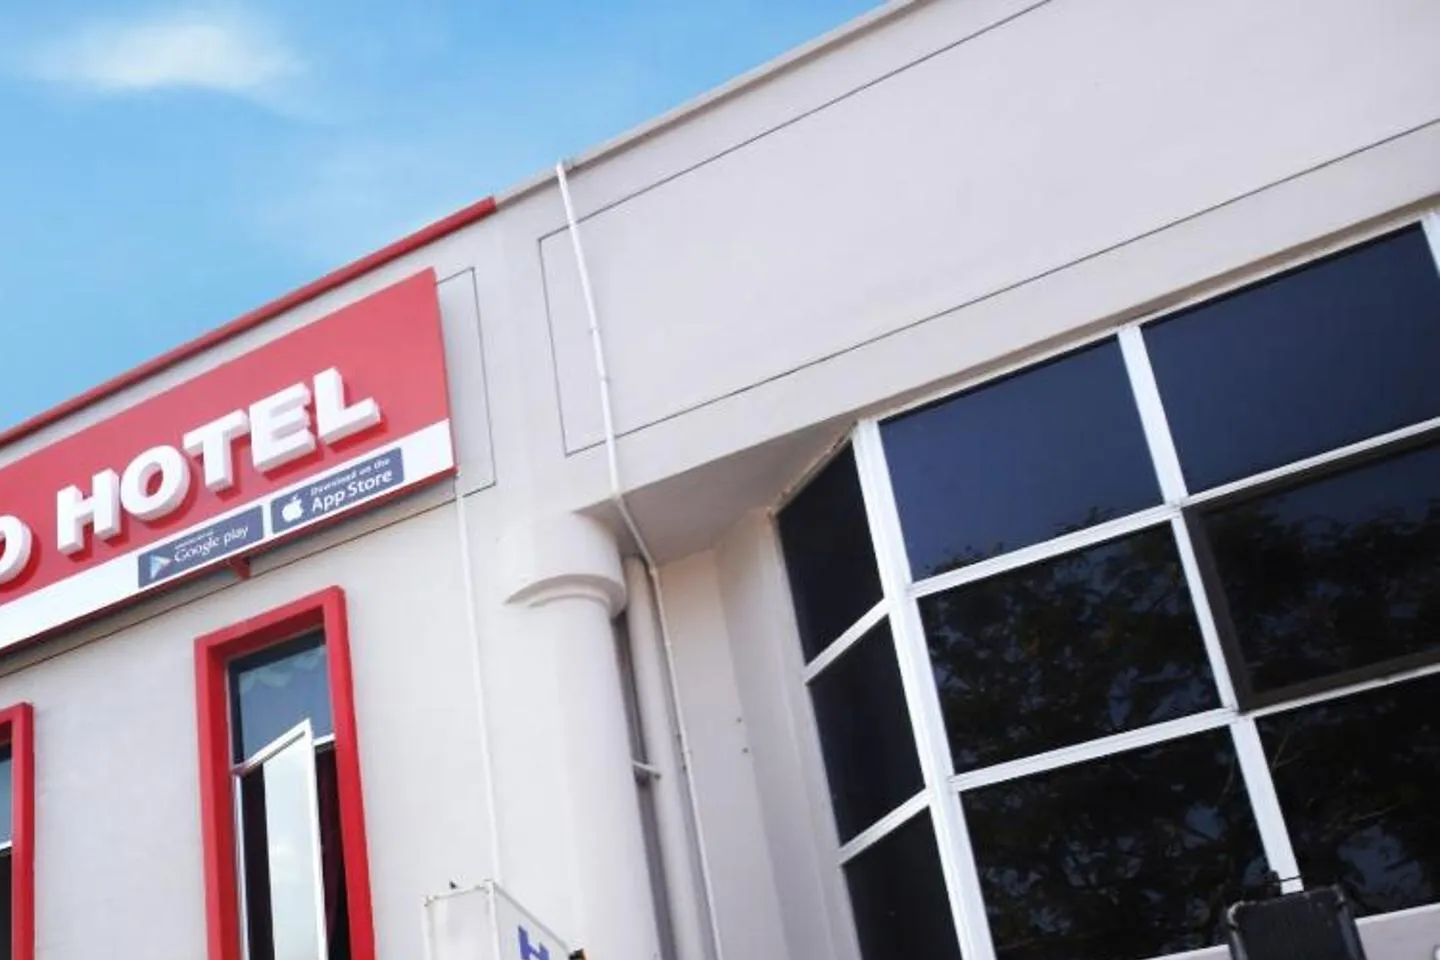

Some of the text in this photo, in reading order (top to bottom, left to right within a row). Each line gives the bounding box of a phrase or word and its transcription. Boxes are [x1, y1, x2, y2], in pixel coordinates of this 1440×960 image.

[57, 366, 381, 554] HOTEL
[311, 468, 393, 514] App Store
[174, 535, 221, 563] Google
[223, 524, 249, 546] play
